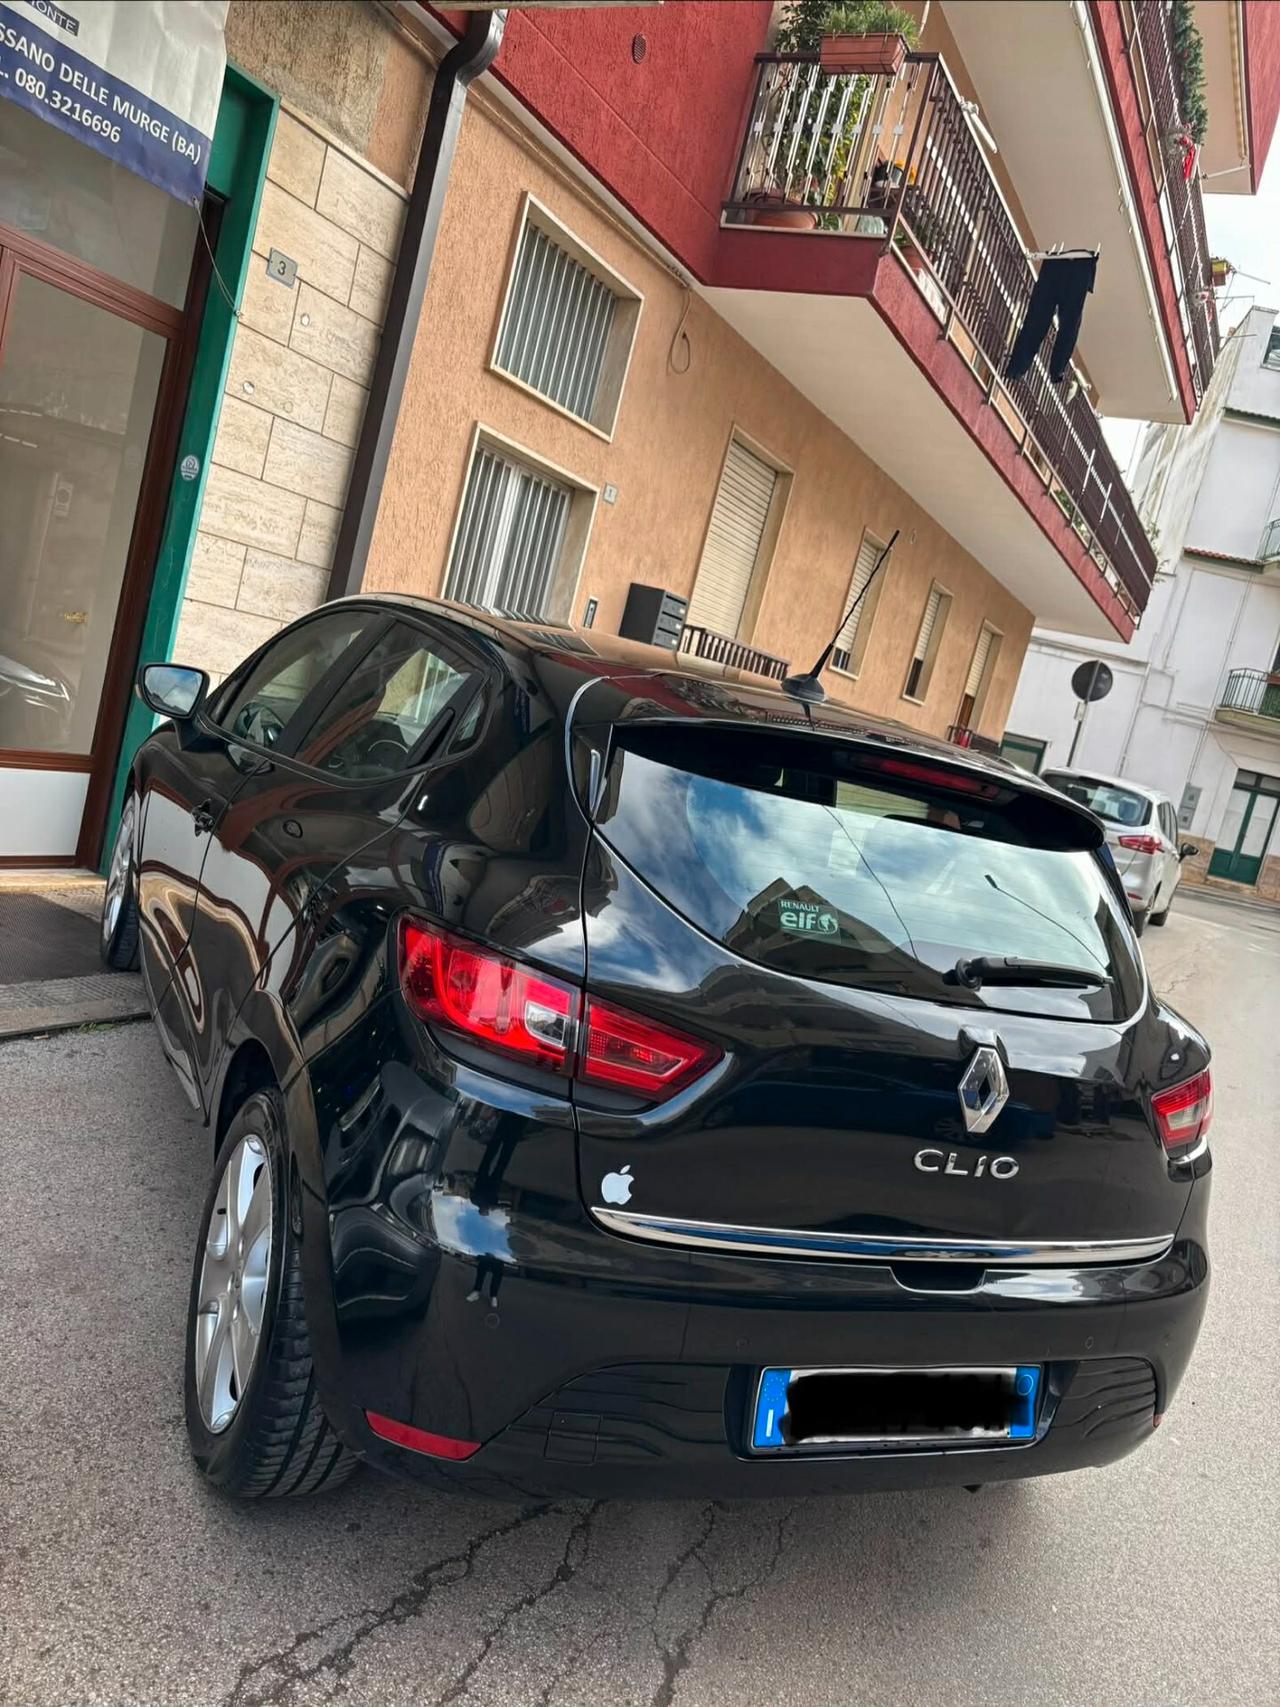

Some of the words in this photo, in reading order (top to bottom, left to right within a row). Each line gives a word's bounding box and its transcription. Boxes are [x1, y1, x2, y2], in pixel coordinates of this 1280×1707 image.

[15, 67, 122, 143] 080.3216696
[59, 62, 109, 106] DELLE
[113, 95, 170, 144] MURGE
[172, 130, 201, 165] (BA)
[276, 260, 287, 276] 3
[780, 900, 820, 913] RENAULT
[780, 911, 816, 930] elf
[914, 1148, 1019, 1179] CLIO
